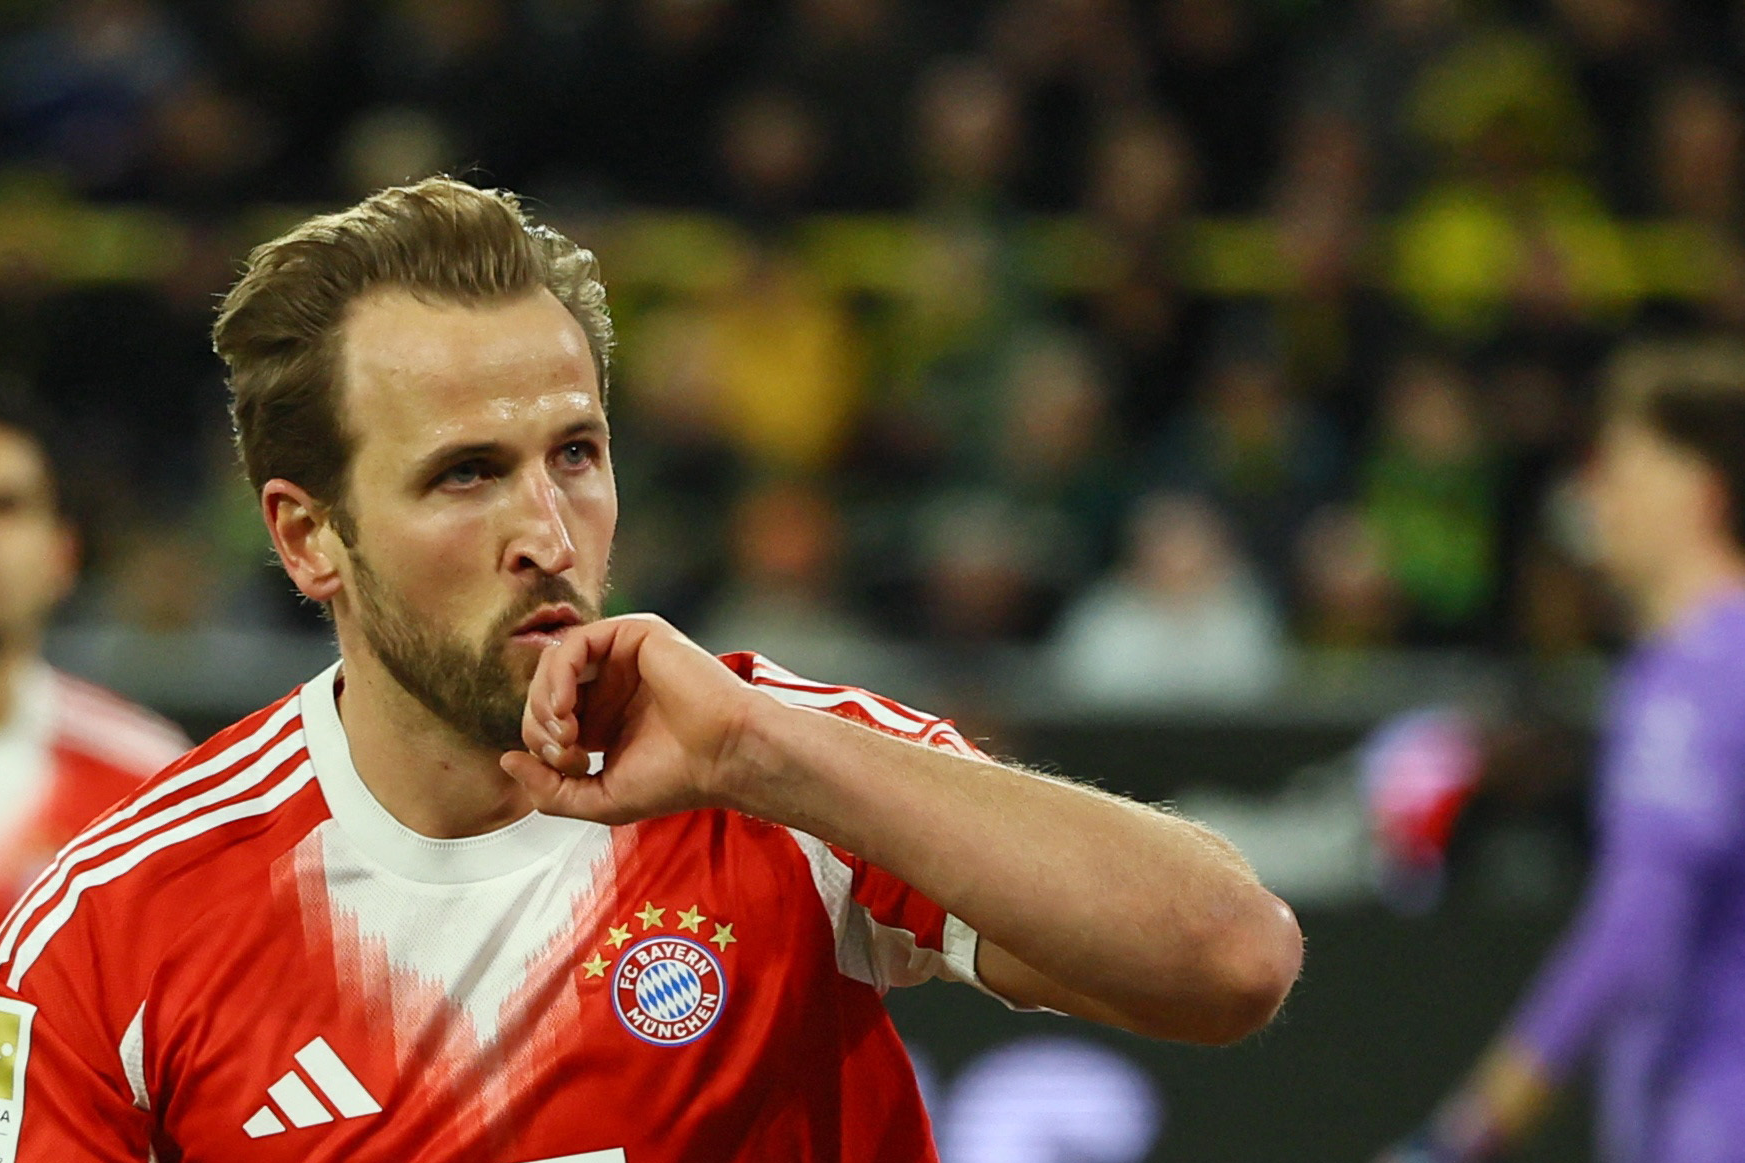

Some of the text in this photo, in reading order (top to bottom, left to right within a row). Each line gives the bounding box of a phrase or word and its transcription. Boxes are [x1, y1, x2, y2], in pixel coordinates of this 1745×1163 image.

[619, 943, 712, 991] FC BAYERN
[626, 992, 718, 1039] MÜNCHEN
